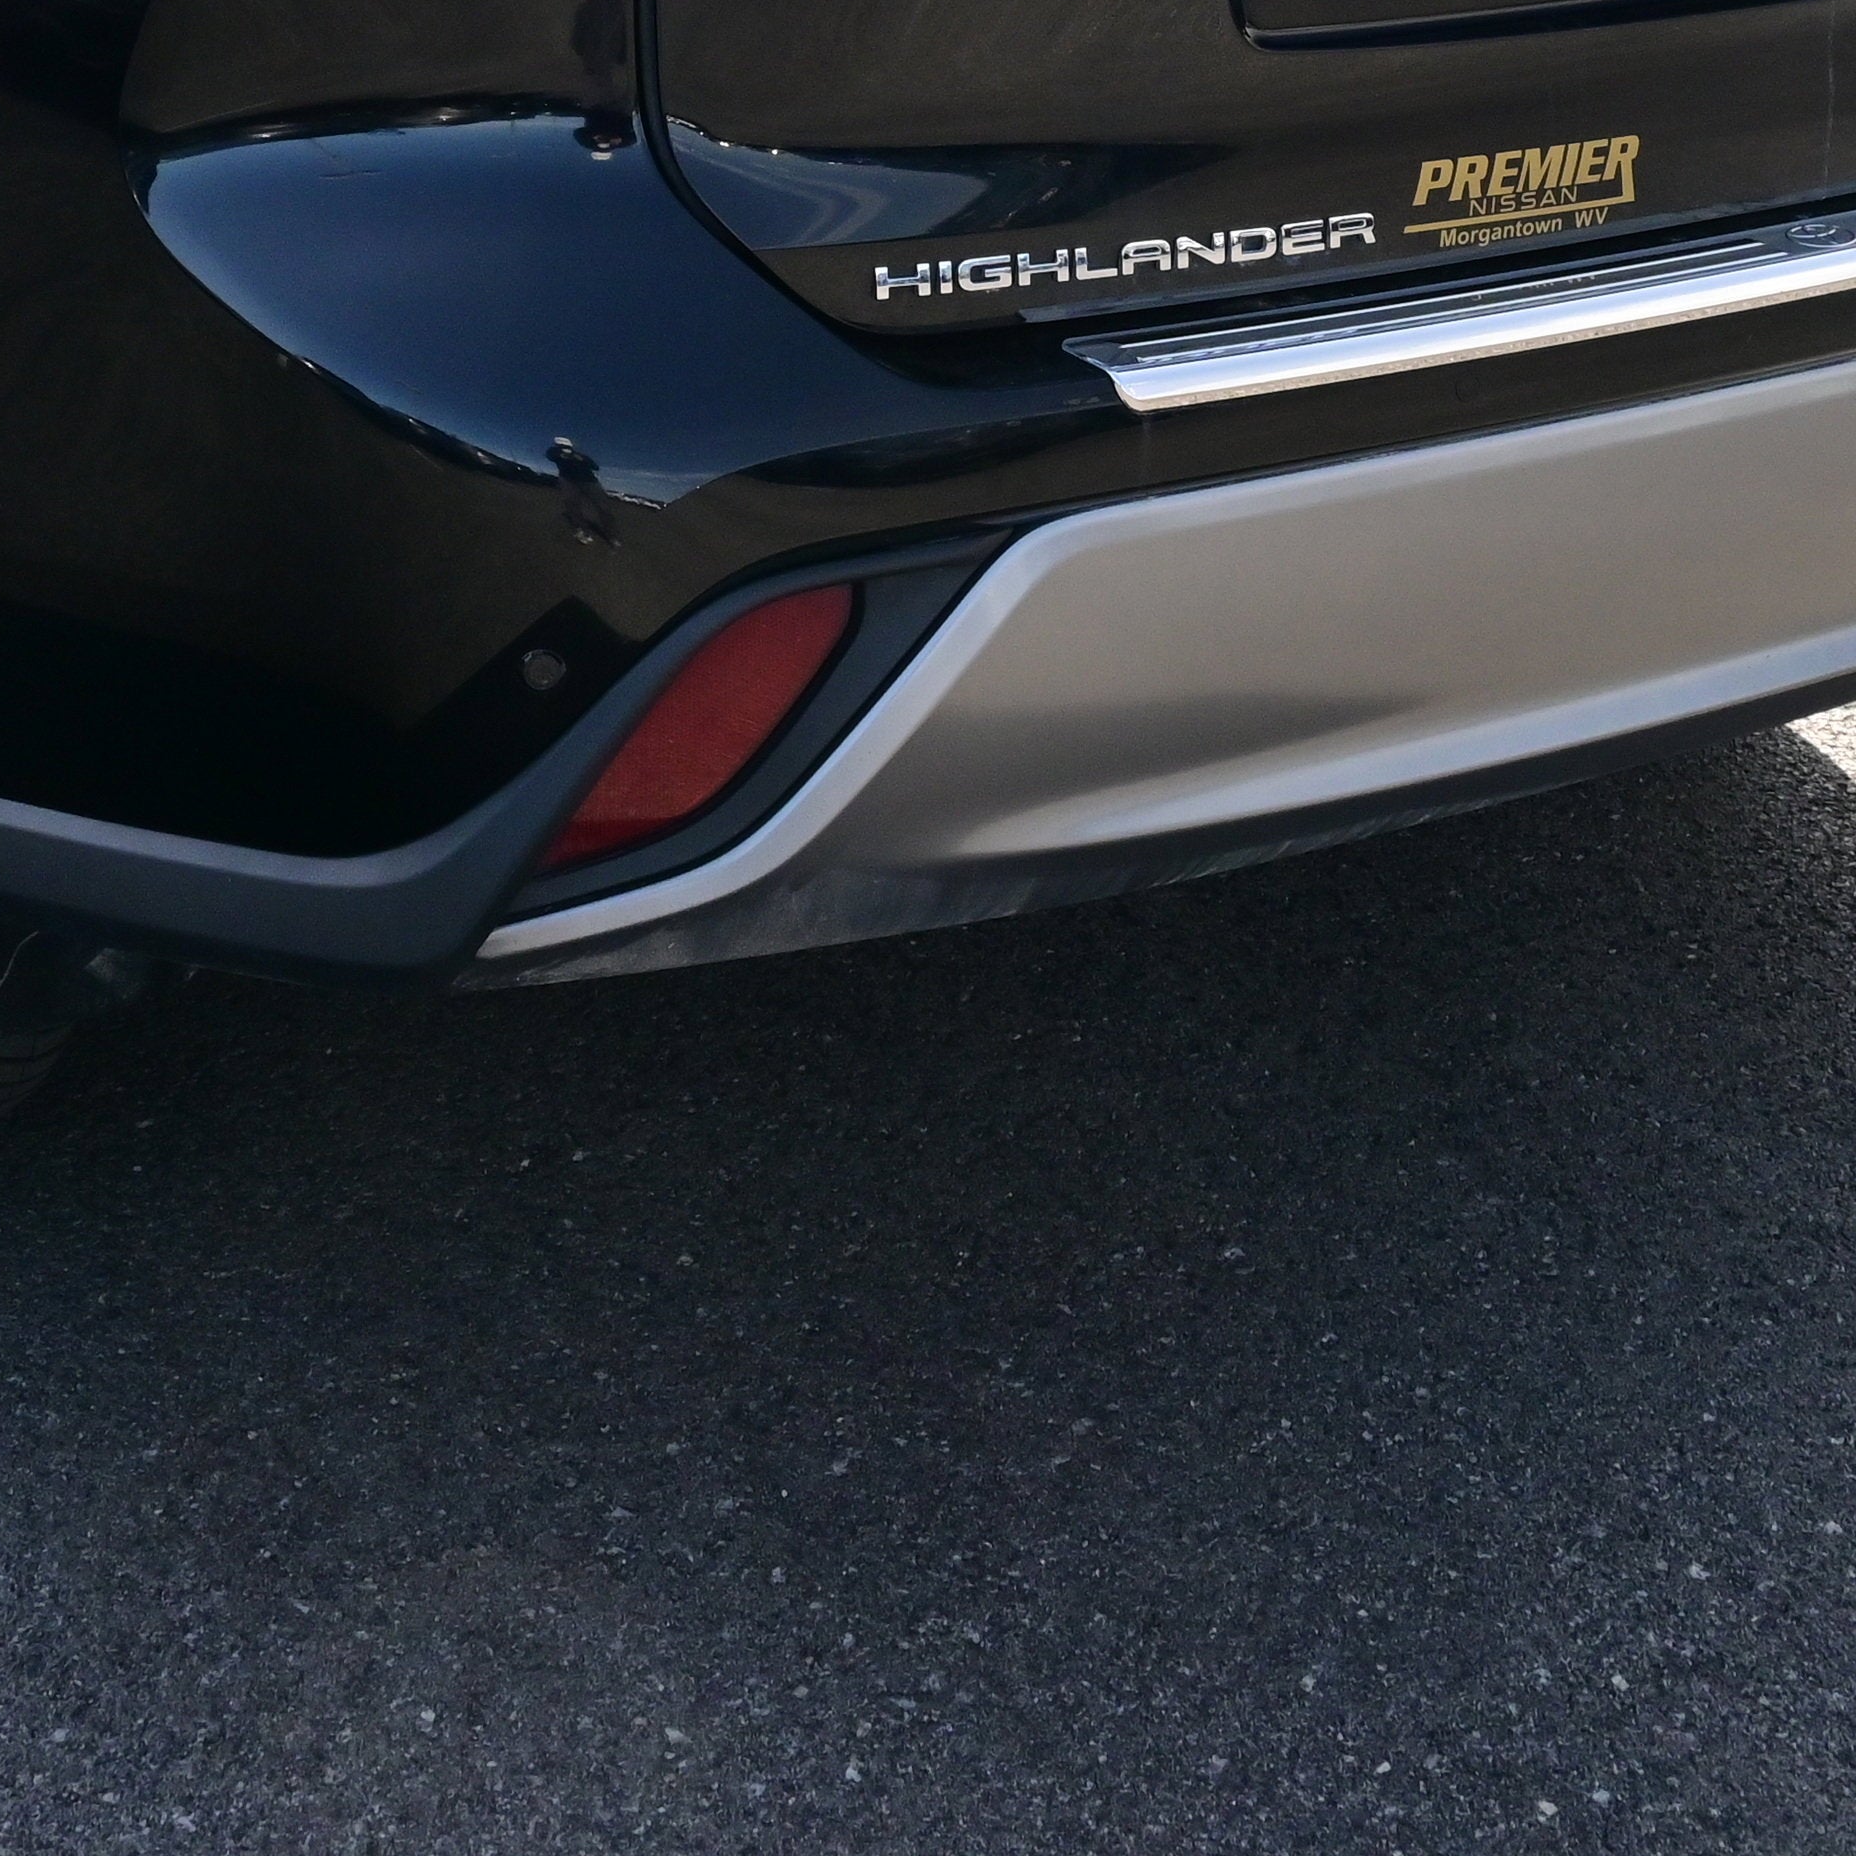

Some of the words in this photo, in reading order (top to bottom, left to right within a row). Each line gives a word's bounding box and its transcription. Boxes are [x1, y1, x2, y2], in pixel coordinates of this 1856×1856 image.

[1411, 134, 1640, 206] PREMIER
[1439, 216, 1564, 248] Morgantown
[1574, 206, 1609, 229] WV
[1468, 185, 1578, 217] NISSAN
[874, 211, 1377, 302] HIGHLANDER
